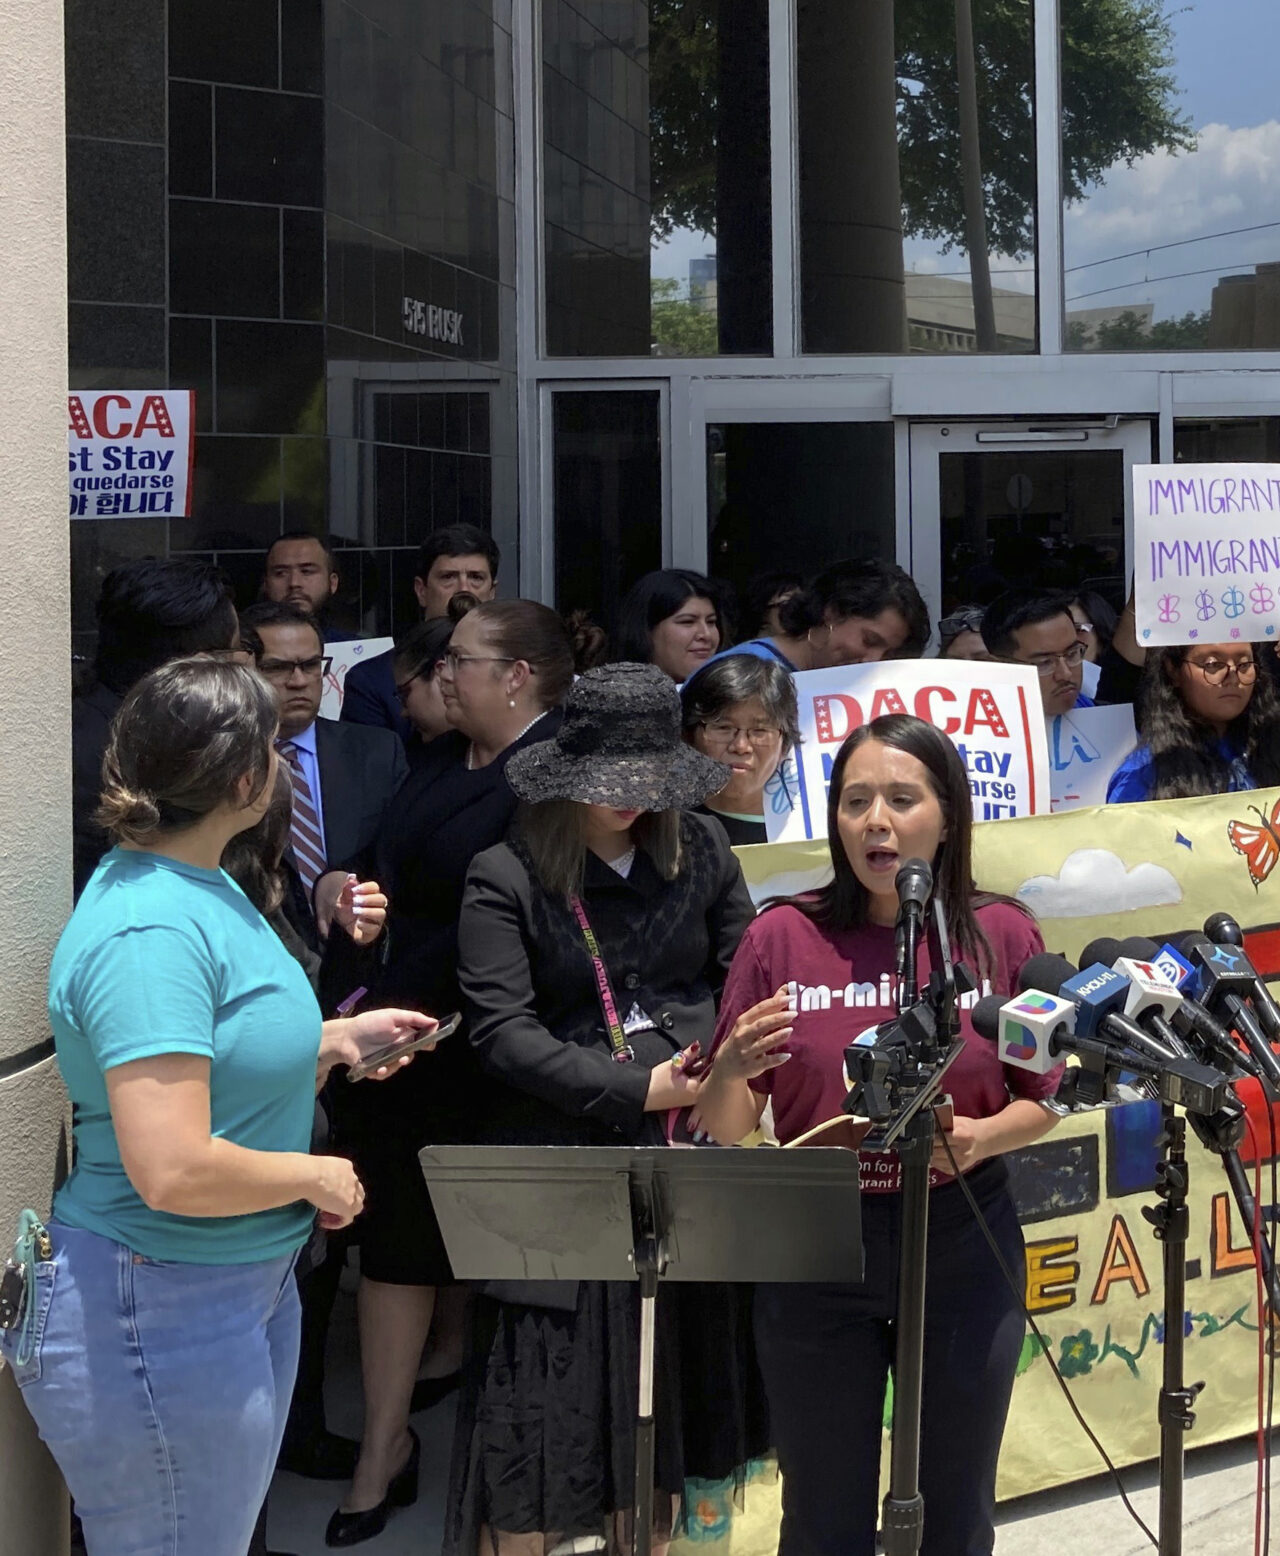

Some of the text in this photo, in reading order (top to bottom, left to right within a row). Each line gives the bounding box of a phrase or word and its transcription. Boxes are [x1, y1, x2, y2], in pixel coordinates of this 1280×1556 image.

[427, 304, 464, 346] RUSK
[68, 395, 175, 439] ACA
[102, 446, 175, 471] Stay
[73, 473, 174, 492] quedarse
[96, 491, 175, 515] 합니다
[957, 743, 1012, 778] tay
[874, 1159, 894, 1173] for
